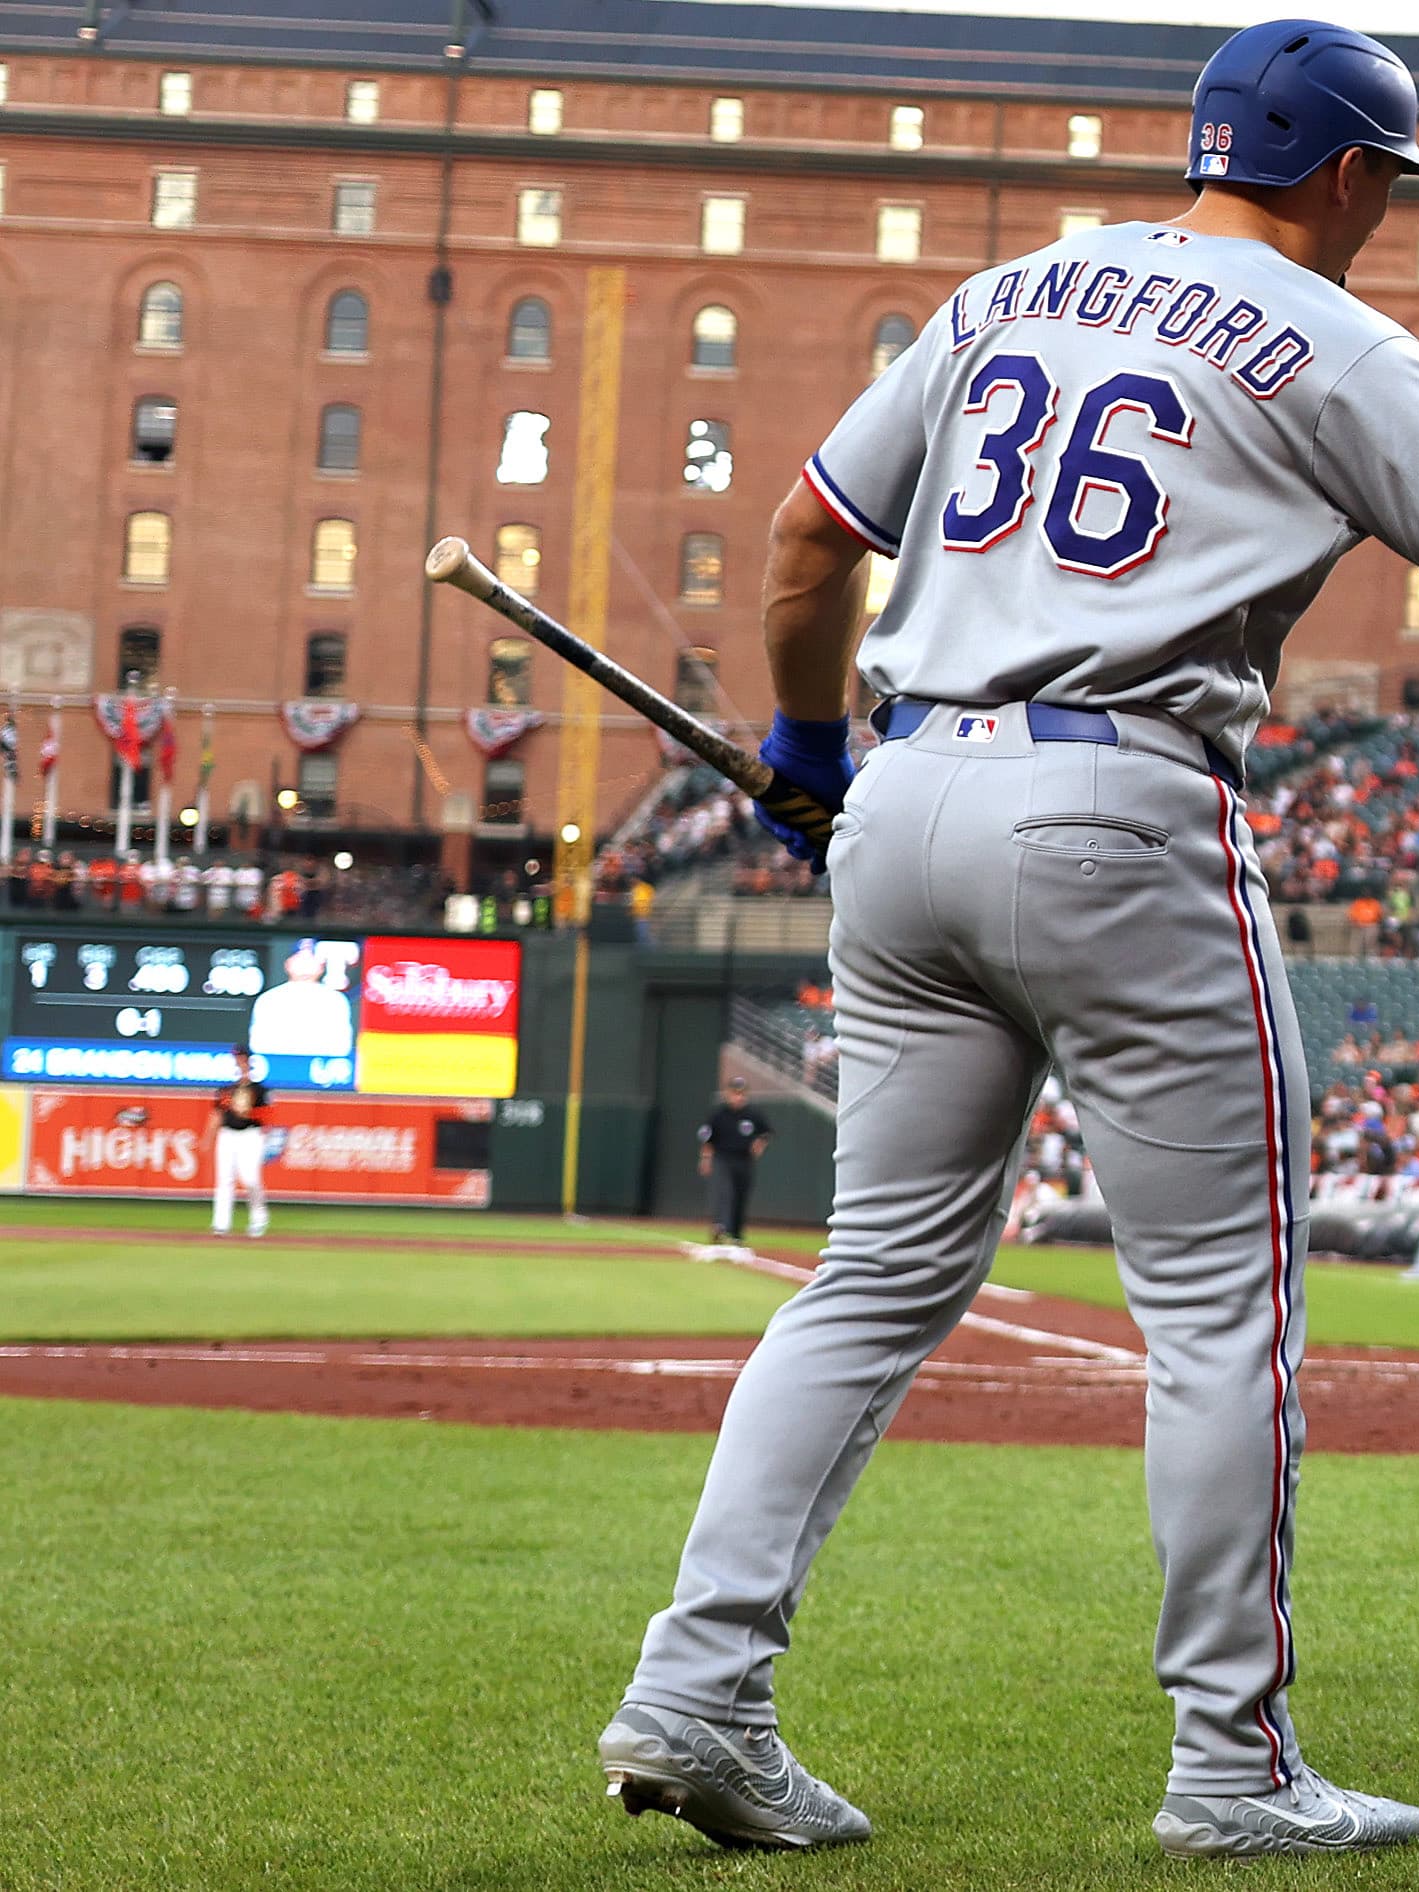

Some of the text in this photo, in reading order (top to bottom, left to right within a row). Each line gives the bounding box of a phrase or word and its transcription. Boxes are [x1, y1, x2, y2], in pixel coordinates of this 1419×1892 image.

[1200, 122, 1233, 151] 36
[950, 259, 1315, 400] LANGFORD
[939, 349, 1196, 580] 36
[60, 1126, 199, 1181] HIGH'S
